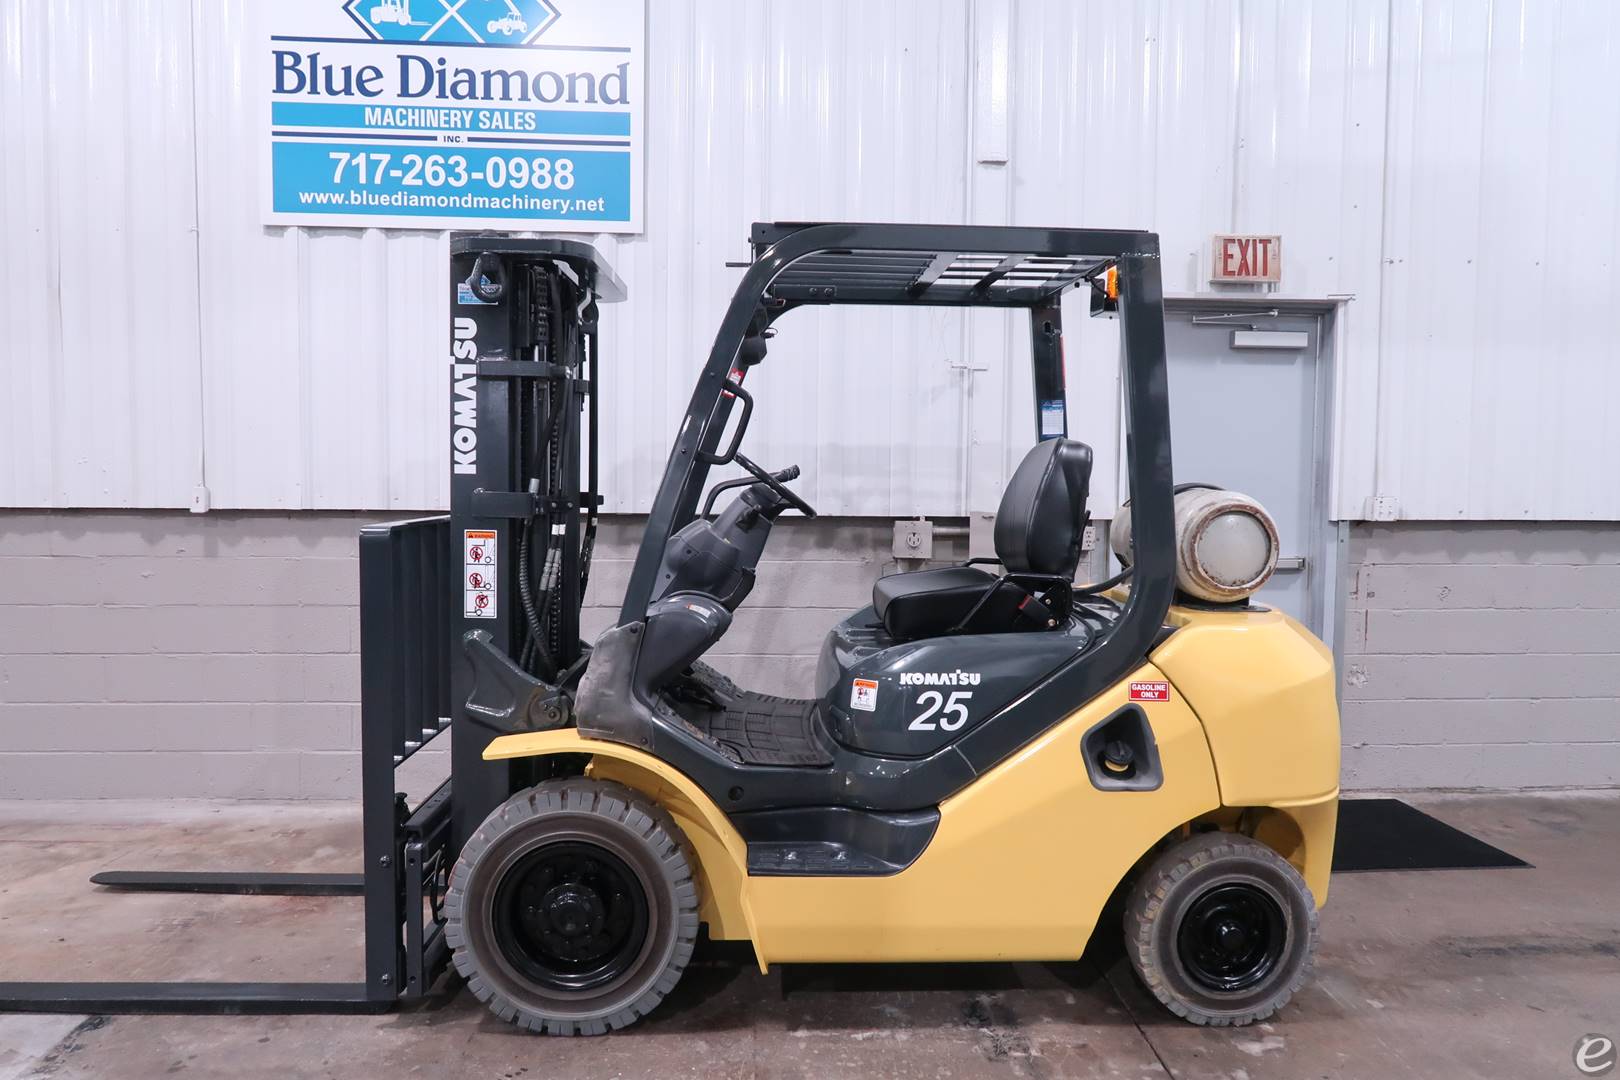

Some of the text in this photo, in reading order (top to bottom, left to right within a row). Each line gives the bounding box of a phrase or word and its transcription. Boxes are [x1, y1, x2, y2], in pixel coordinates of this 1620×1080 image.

[271, 50, 631, 105] Blue Diamond
[364, 107, 537, 131] MACHINERY SALES
[443, 135, 464, 144] INC.
[329, 152, 574, 189] 717-263-0988
[299, 190, 605, 214] www.bluediamondmachinery.net
[1223, 239, 1272, 276] EXIT
[451, 317, 477, 474] KOMATSU
[899, 670, 981, 686] KOMATSU
[908, 690, 973, 731] 25
